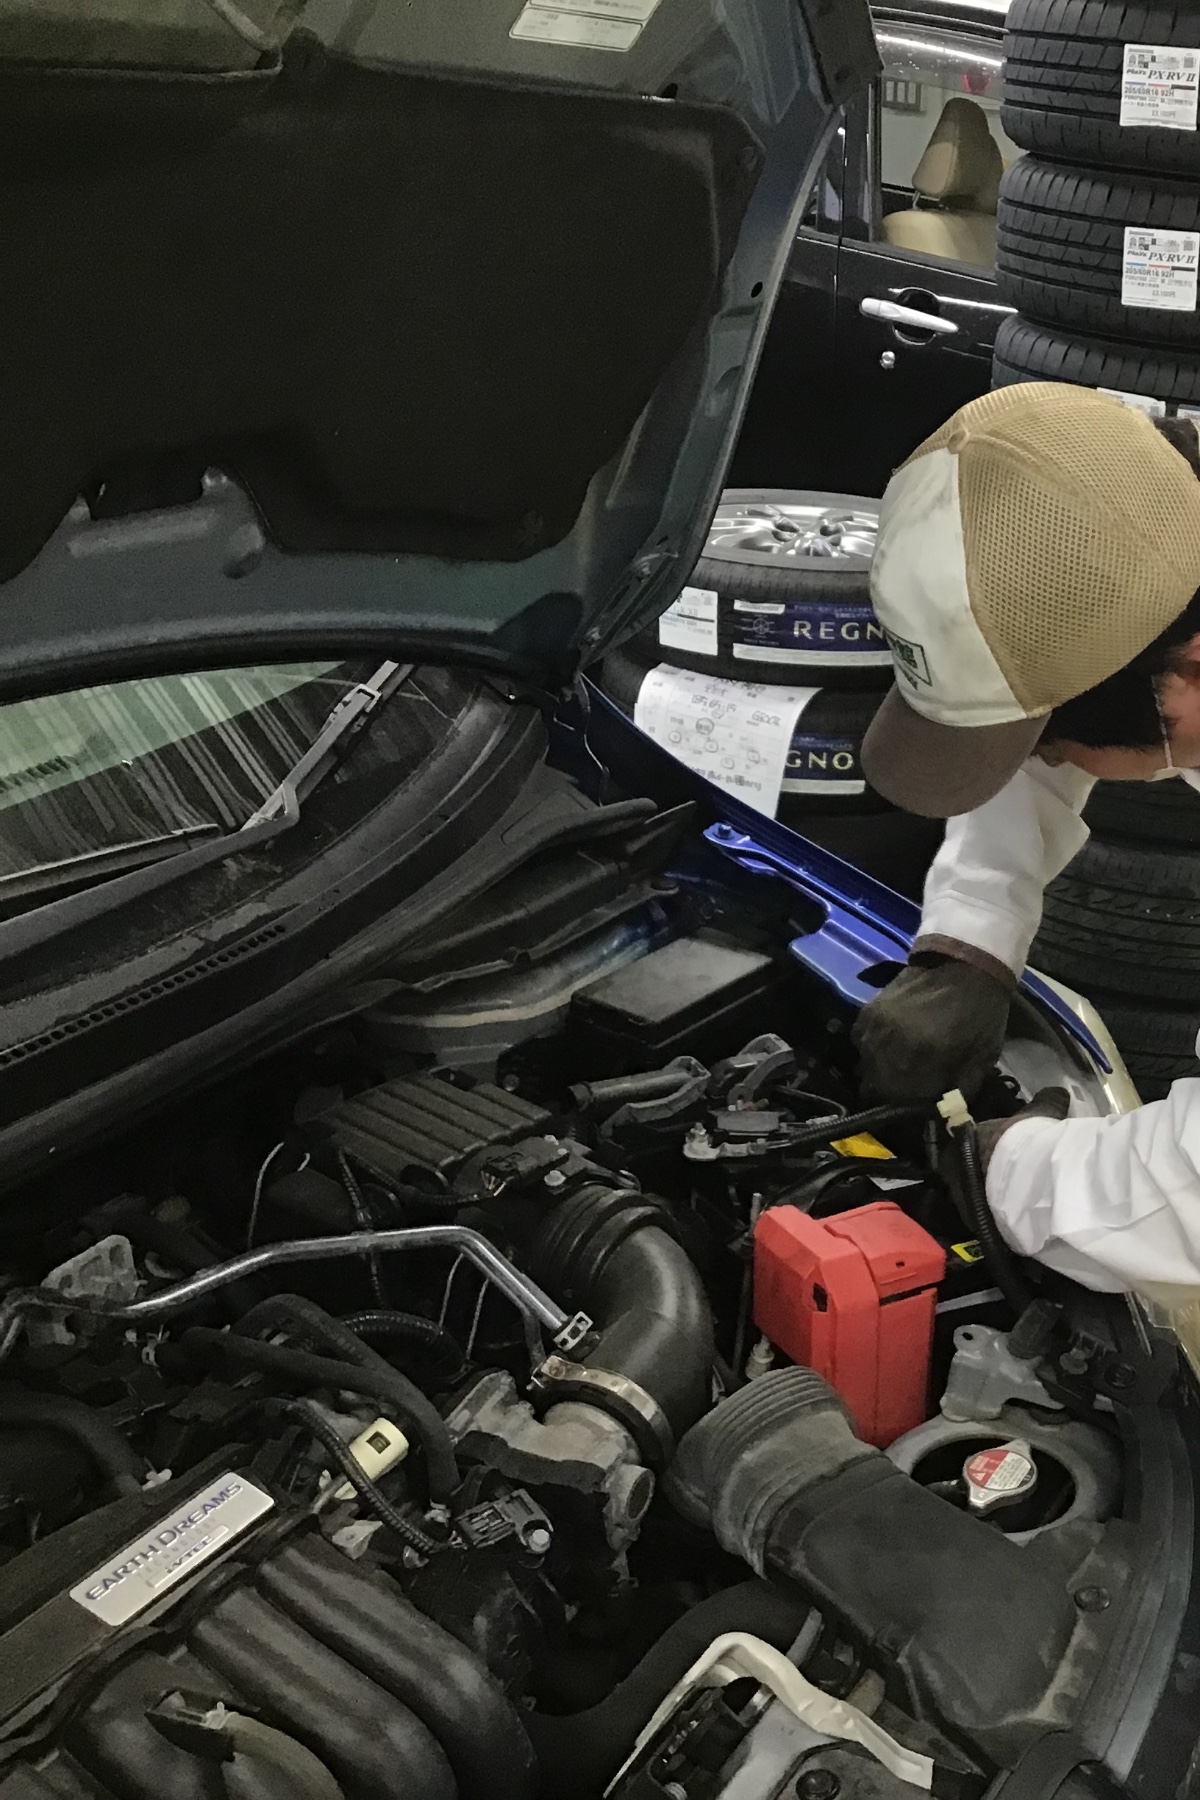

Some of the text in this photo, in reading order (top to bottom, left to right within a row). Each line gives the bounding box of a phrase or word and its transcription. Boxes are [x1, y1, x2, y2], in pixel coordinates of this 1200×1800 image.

[85, 1481, 244, 1601] EARTH DREAMS
[137, 1517, 219, 1580] TECHNOLOGY
